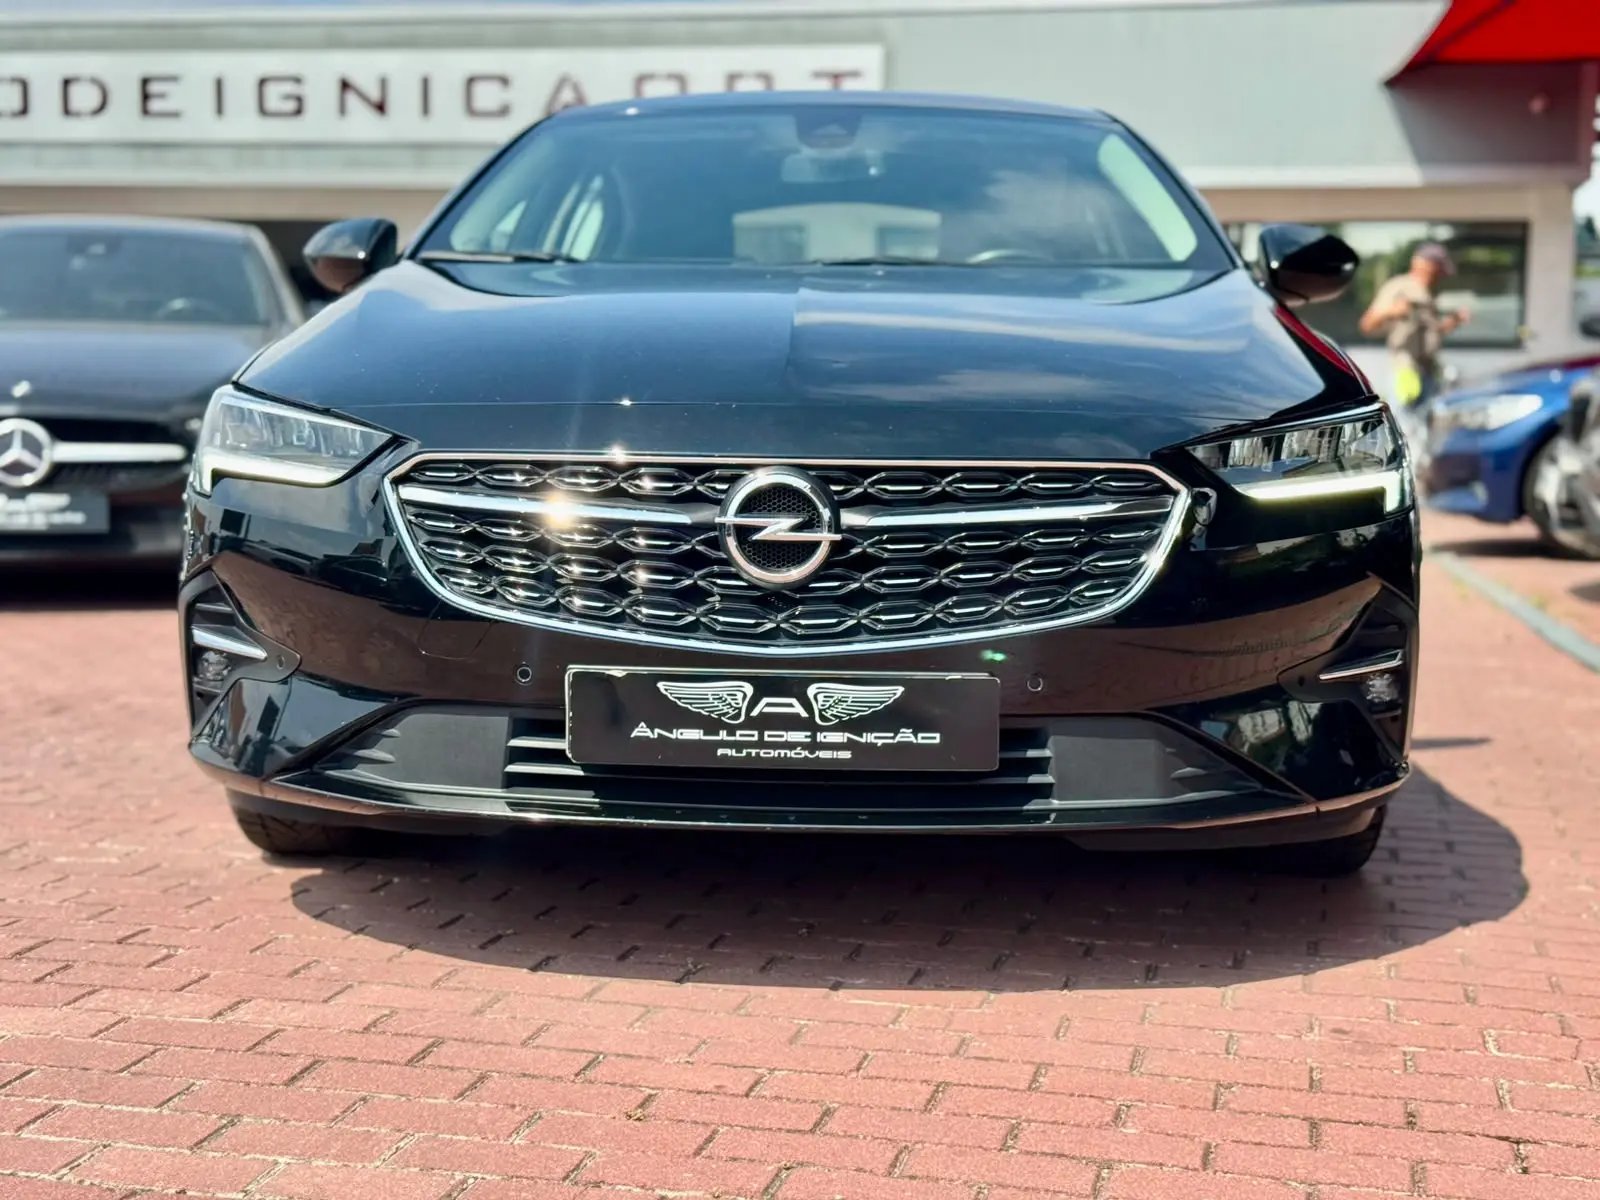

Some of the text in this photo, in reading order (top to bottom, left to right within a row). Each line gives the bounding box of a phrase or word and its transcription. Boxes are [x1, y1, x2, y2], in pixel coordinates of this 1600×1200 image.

[750, 697, 809, 717] A
[630, 722, 940, 747] ÂNGULO DE IGNIÇÃO
[717, 747, 852, 759] AUTOMÓVEIS
